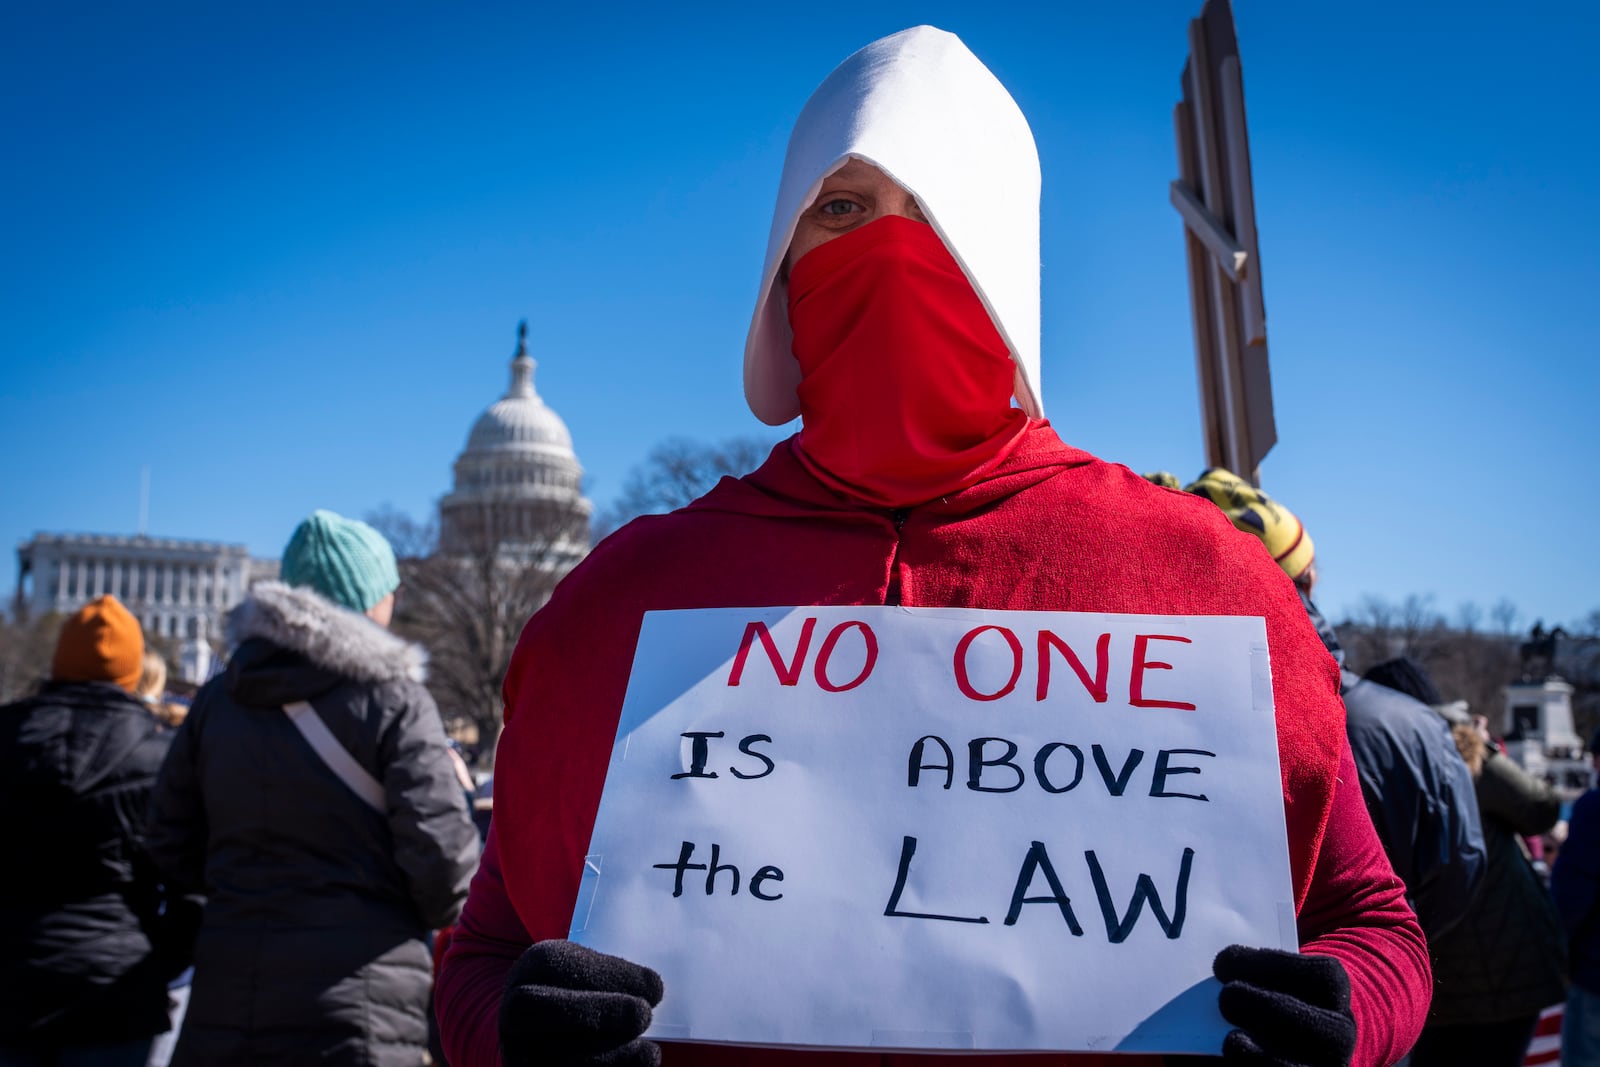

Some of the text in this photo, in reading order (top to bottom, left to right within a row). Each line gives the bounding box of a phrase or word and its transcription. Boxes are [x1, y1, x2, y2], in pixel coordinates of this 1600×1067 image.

[727, 617, 1196, 710] NO ONE
[670, 731, 1217, 802] IS ABOVE
[652, 835, 1195, 944] the LAW
